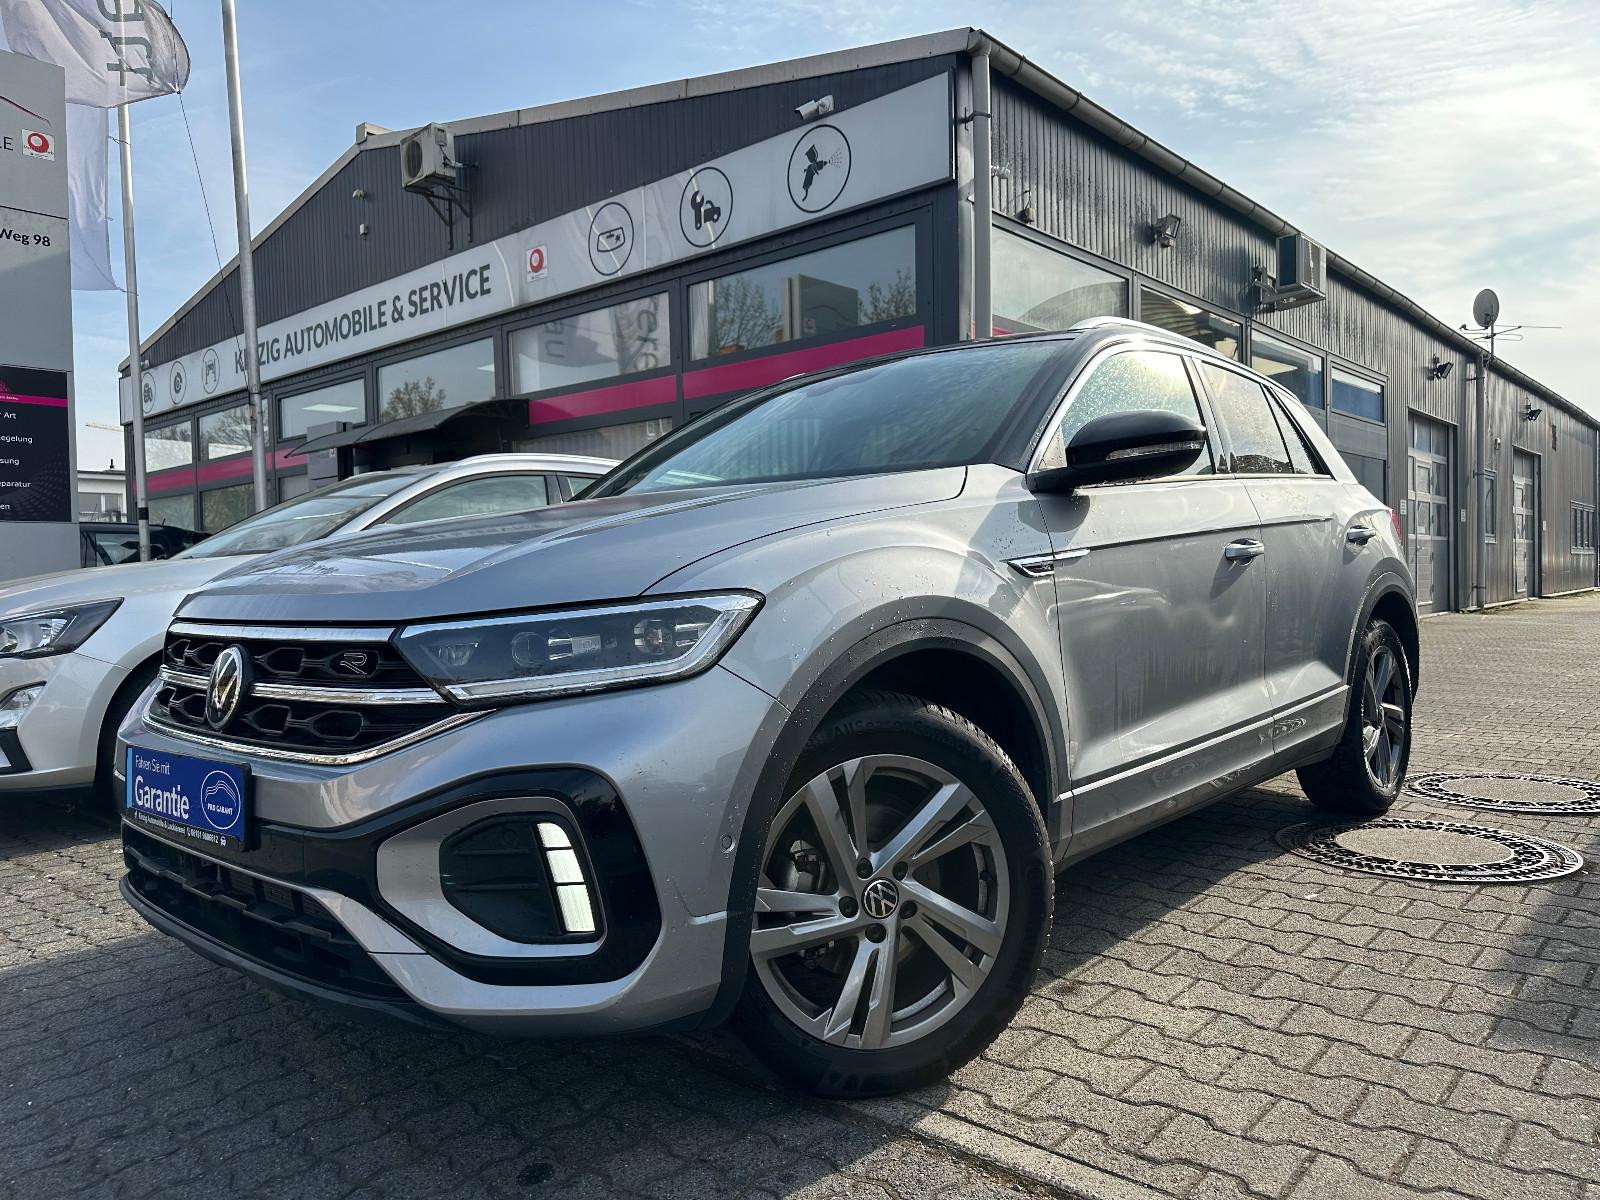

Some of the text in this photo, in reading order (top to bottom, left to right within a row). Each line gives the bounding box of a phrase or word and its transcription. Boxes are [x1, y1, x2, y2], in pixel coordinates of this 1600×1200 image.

[0, 228, 51, 247] Weg 98
[283, 300, 388, 360] AUTOMOBILE
[391, 295, 404, 323] &
[408, 264, 491, 318] SERVICE
[3, 411, 17, 420] Art
[135, 754, 171, 776] Fahren Sie mit
[134, 775, 190, 820] Garantie
